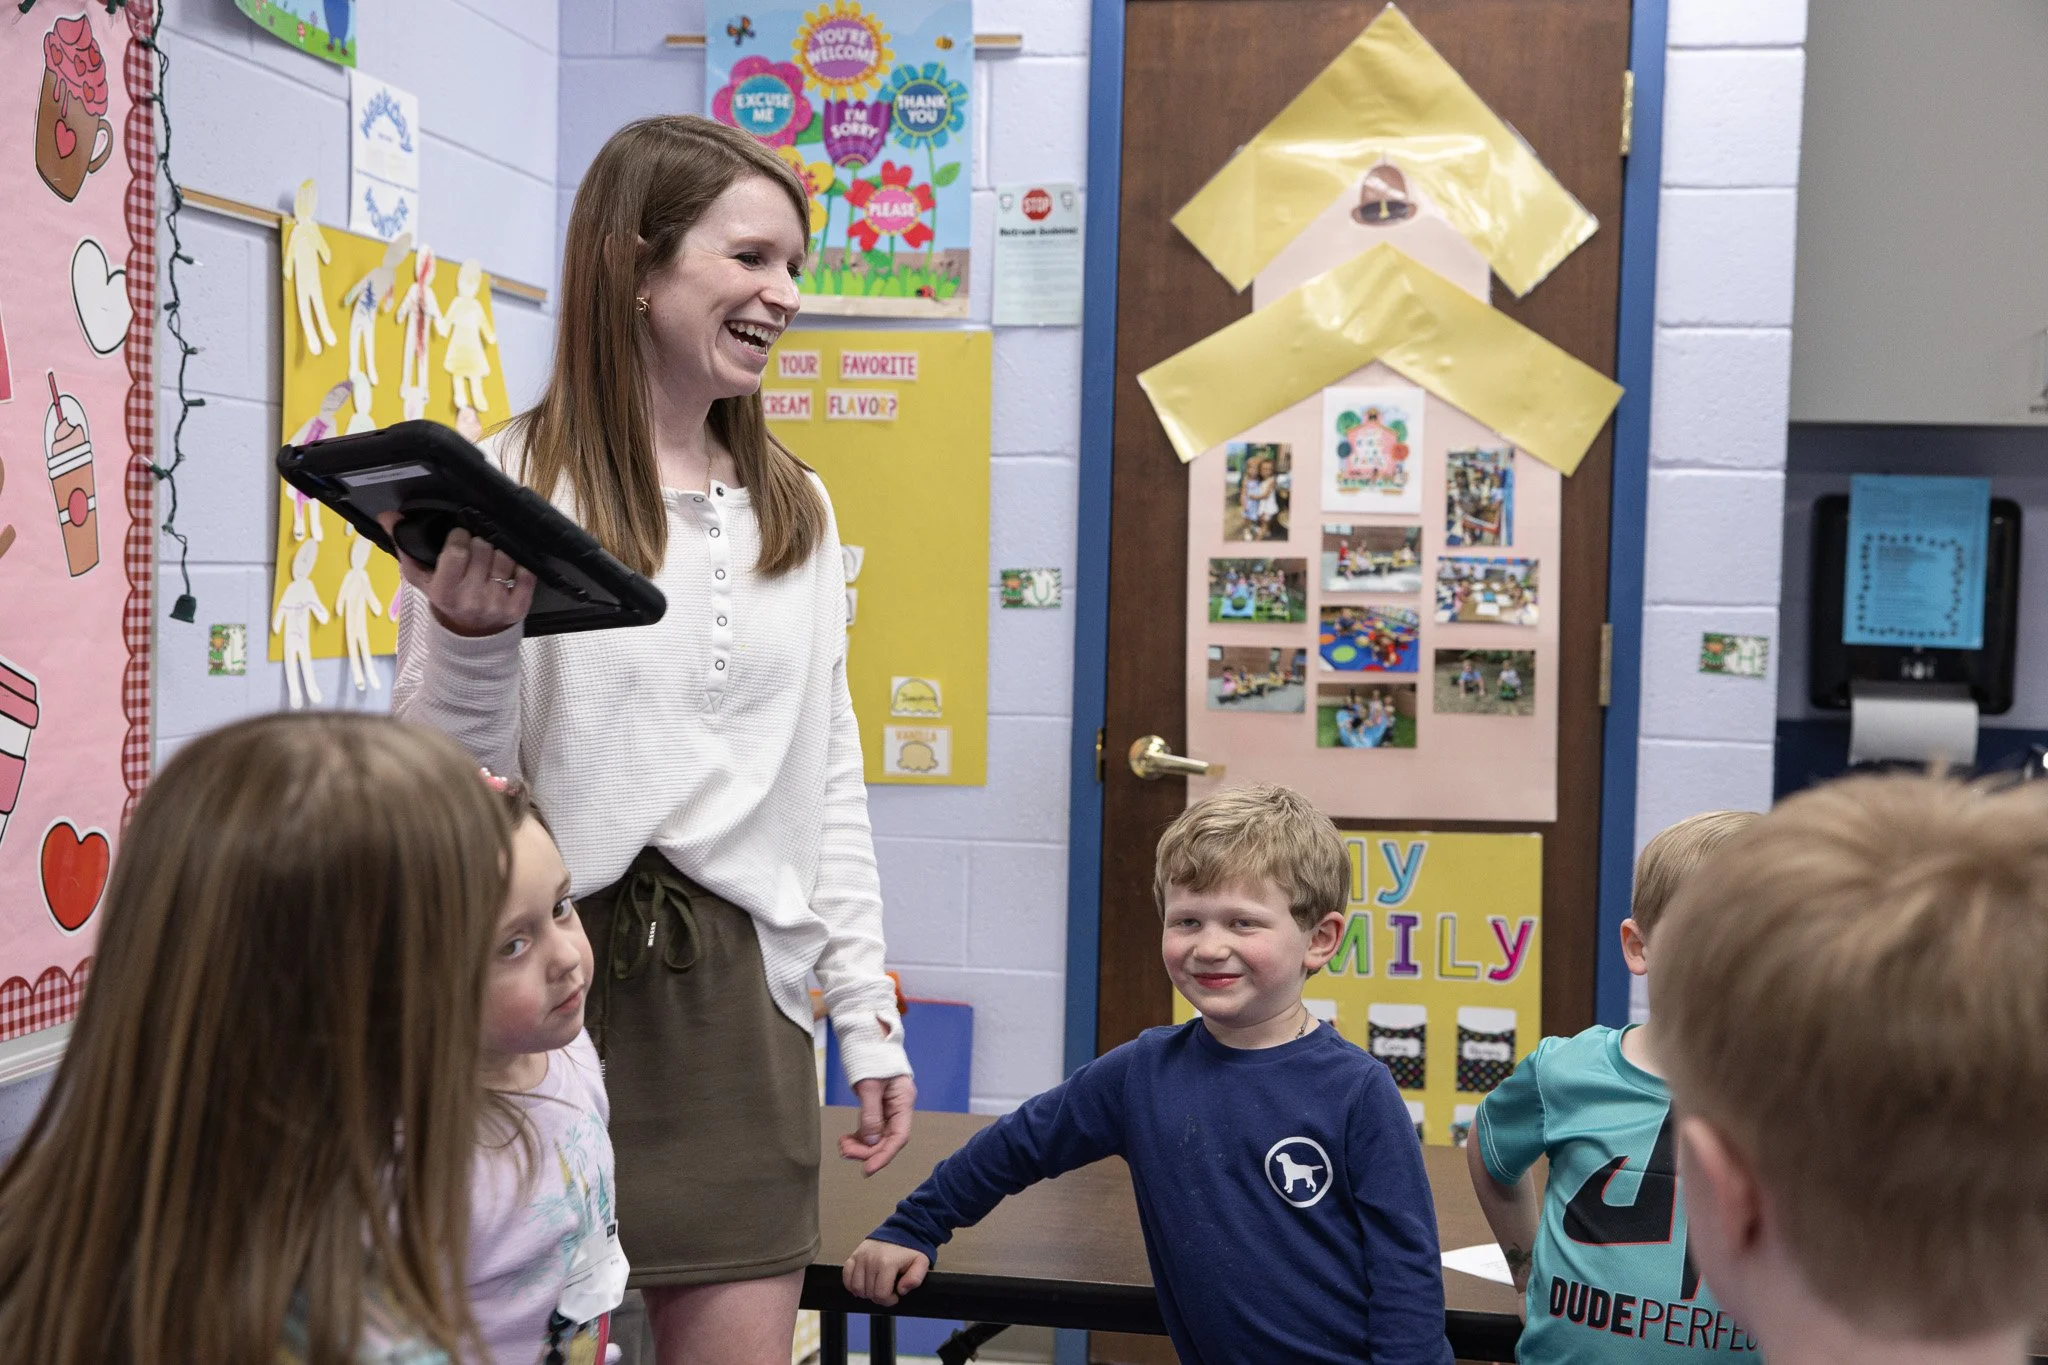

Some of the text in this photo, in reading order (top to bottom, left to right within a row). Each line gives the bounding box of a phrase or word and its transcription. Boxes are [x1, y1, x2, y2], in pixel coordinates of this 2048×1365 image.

[815, 27, 872, 46] YOU'RE
[806, 44, 877, 66] WELCOME
[735, 92, 792, 109] EXCUSE
[897, 94, 947, 110] THANK
[752, 108, 774, 122] ME
[844, 108, 868, 123] I'M
[907, 109, 938, 124] YOU
[830, 121, 879, 139] SORRY
[869, 201, 916, 218] PLEASE
[780, 355, 916, 376] YOUR FAVORITE
[763, 395, 897, 417] CREAM FLAVOR?
